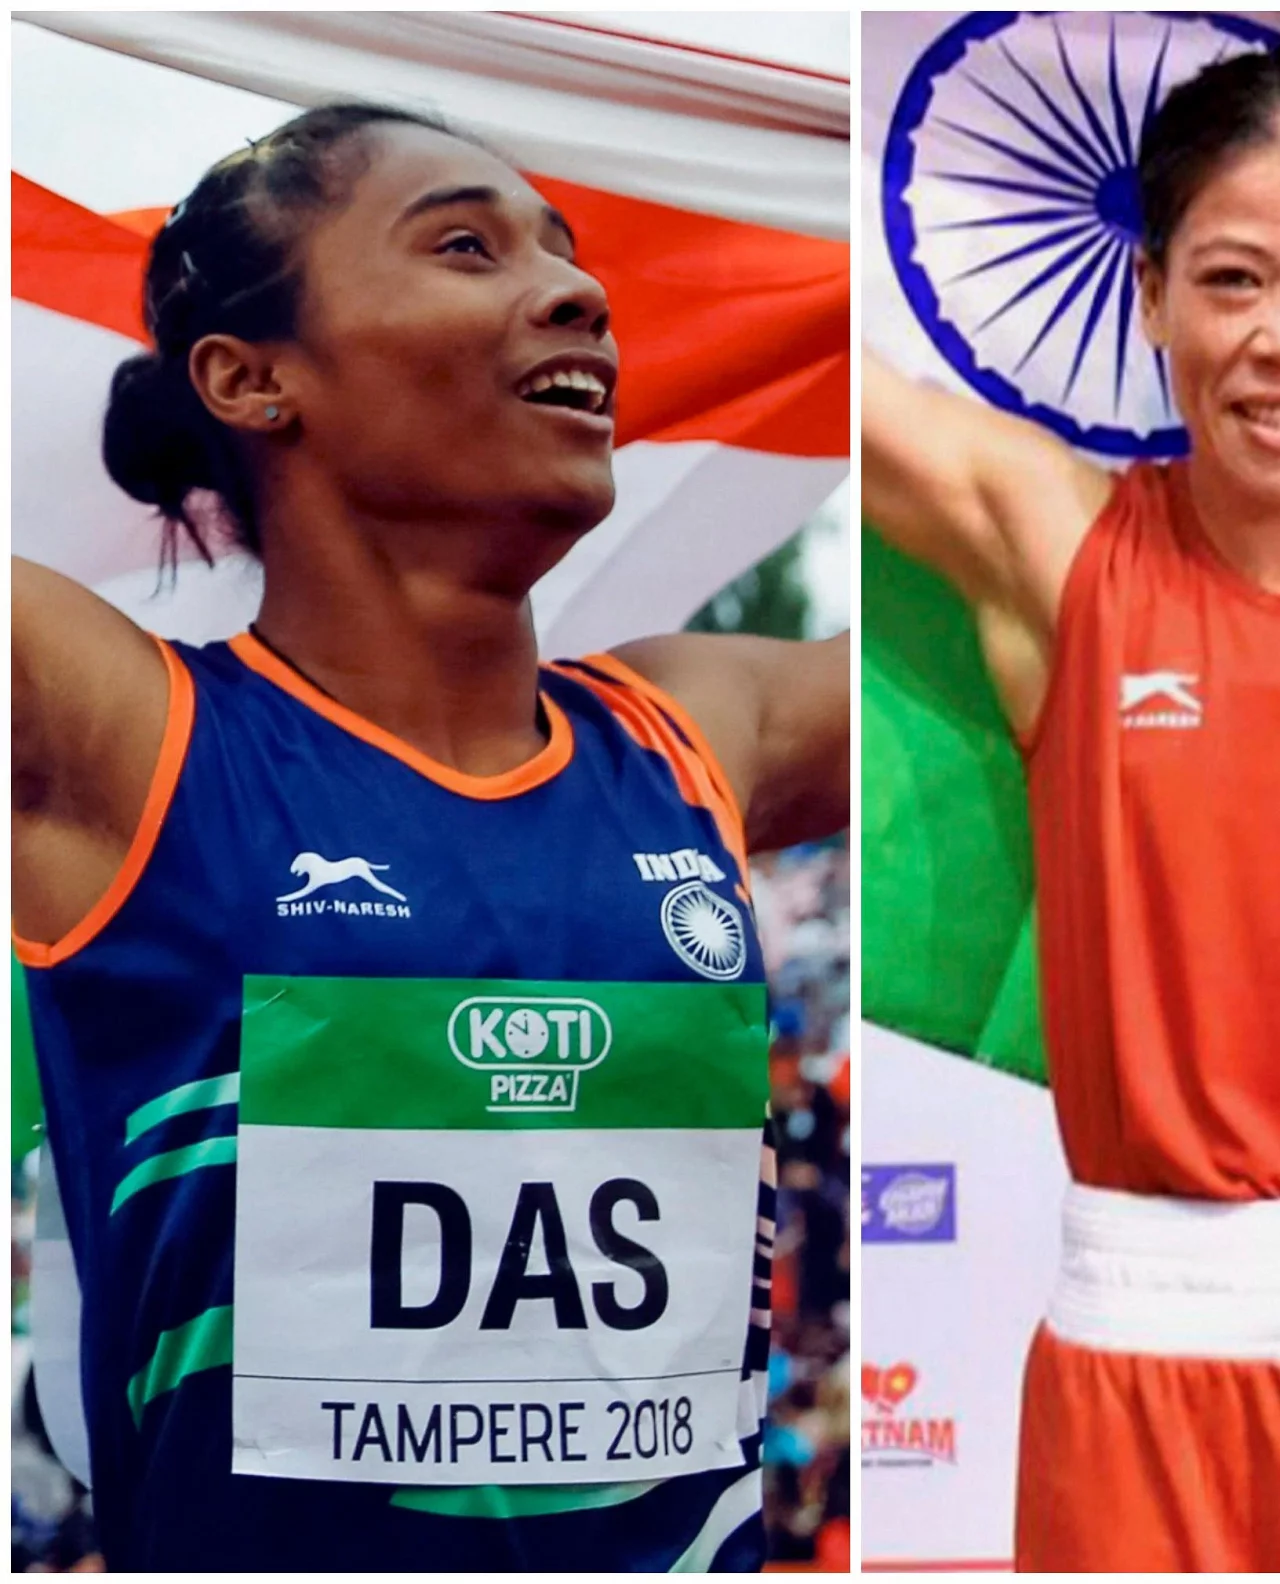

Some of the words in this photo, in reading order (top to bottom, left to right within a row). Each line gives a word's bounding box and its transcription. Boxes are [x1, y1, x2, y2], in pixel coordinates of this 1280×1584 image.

[632, 848, 727, 882] INDA
[277, 900, 411, 918] SHIV-NARESH
[469, 1008, 591, 1059] KOTI
[491, 1075, 567, 1101] PIZZA
[370, 1177, 669, 1330] DAS
[321, 1402, 586, 1462] TAMPERE
[606, 1396, 693, 1460] 2018
